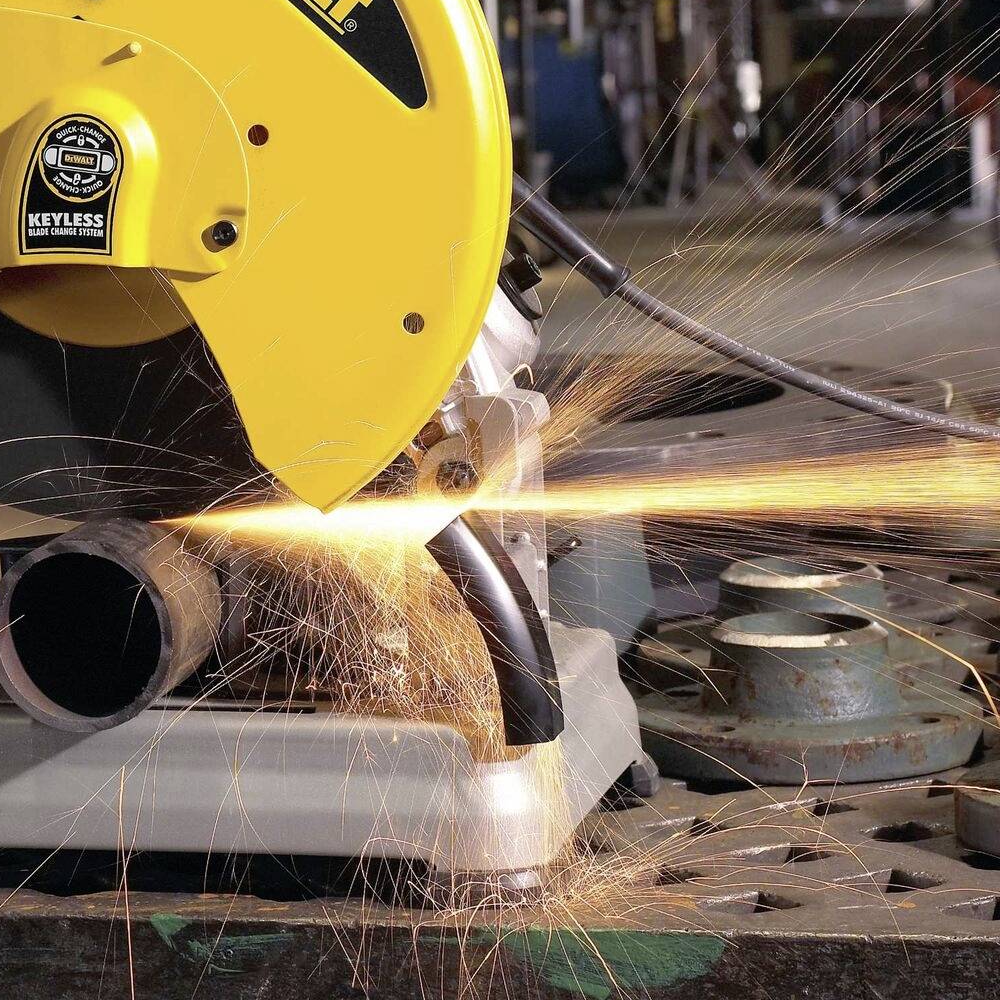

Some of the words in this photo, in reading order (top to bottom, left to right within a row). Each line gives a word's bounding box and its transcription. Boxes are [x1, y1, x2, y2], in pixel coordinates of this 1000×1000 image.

[28, 212, 104, 228] KEYLESS
[28, 228, 49, 237] BLADE
[50, 227, 77, 236] CHANGE
[78, 228, 104, 238] SYSTEM
